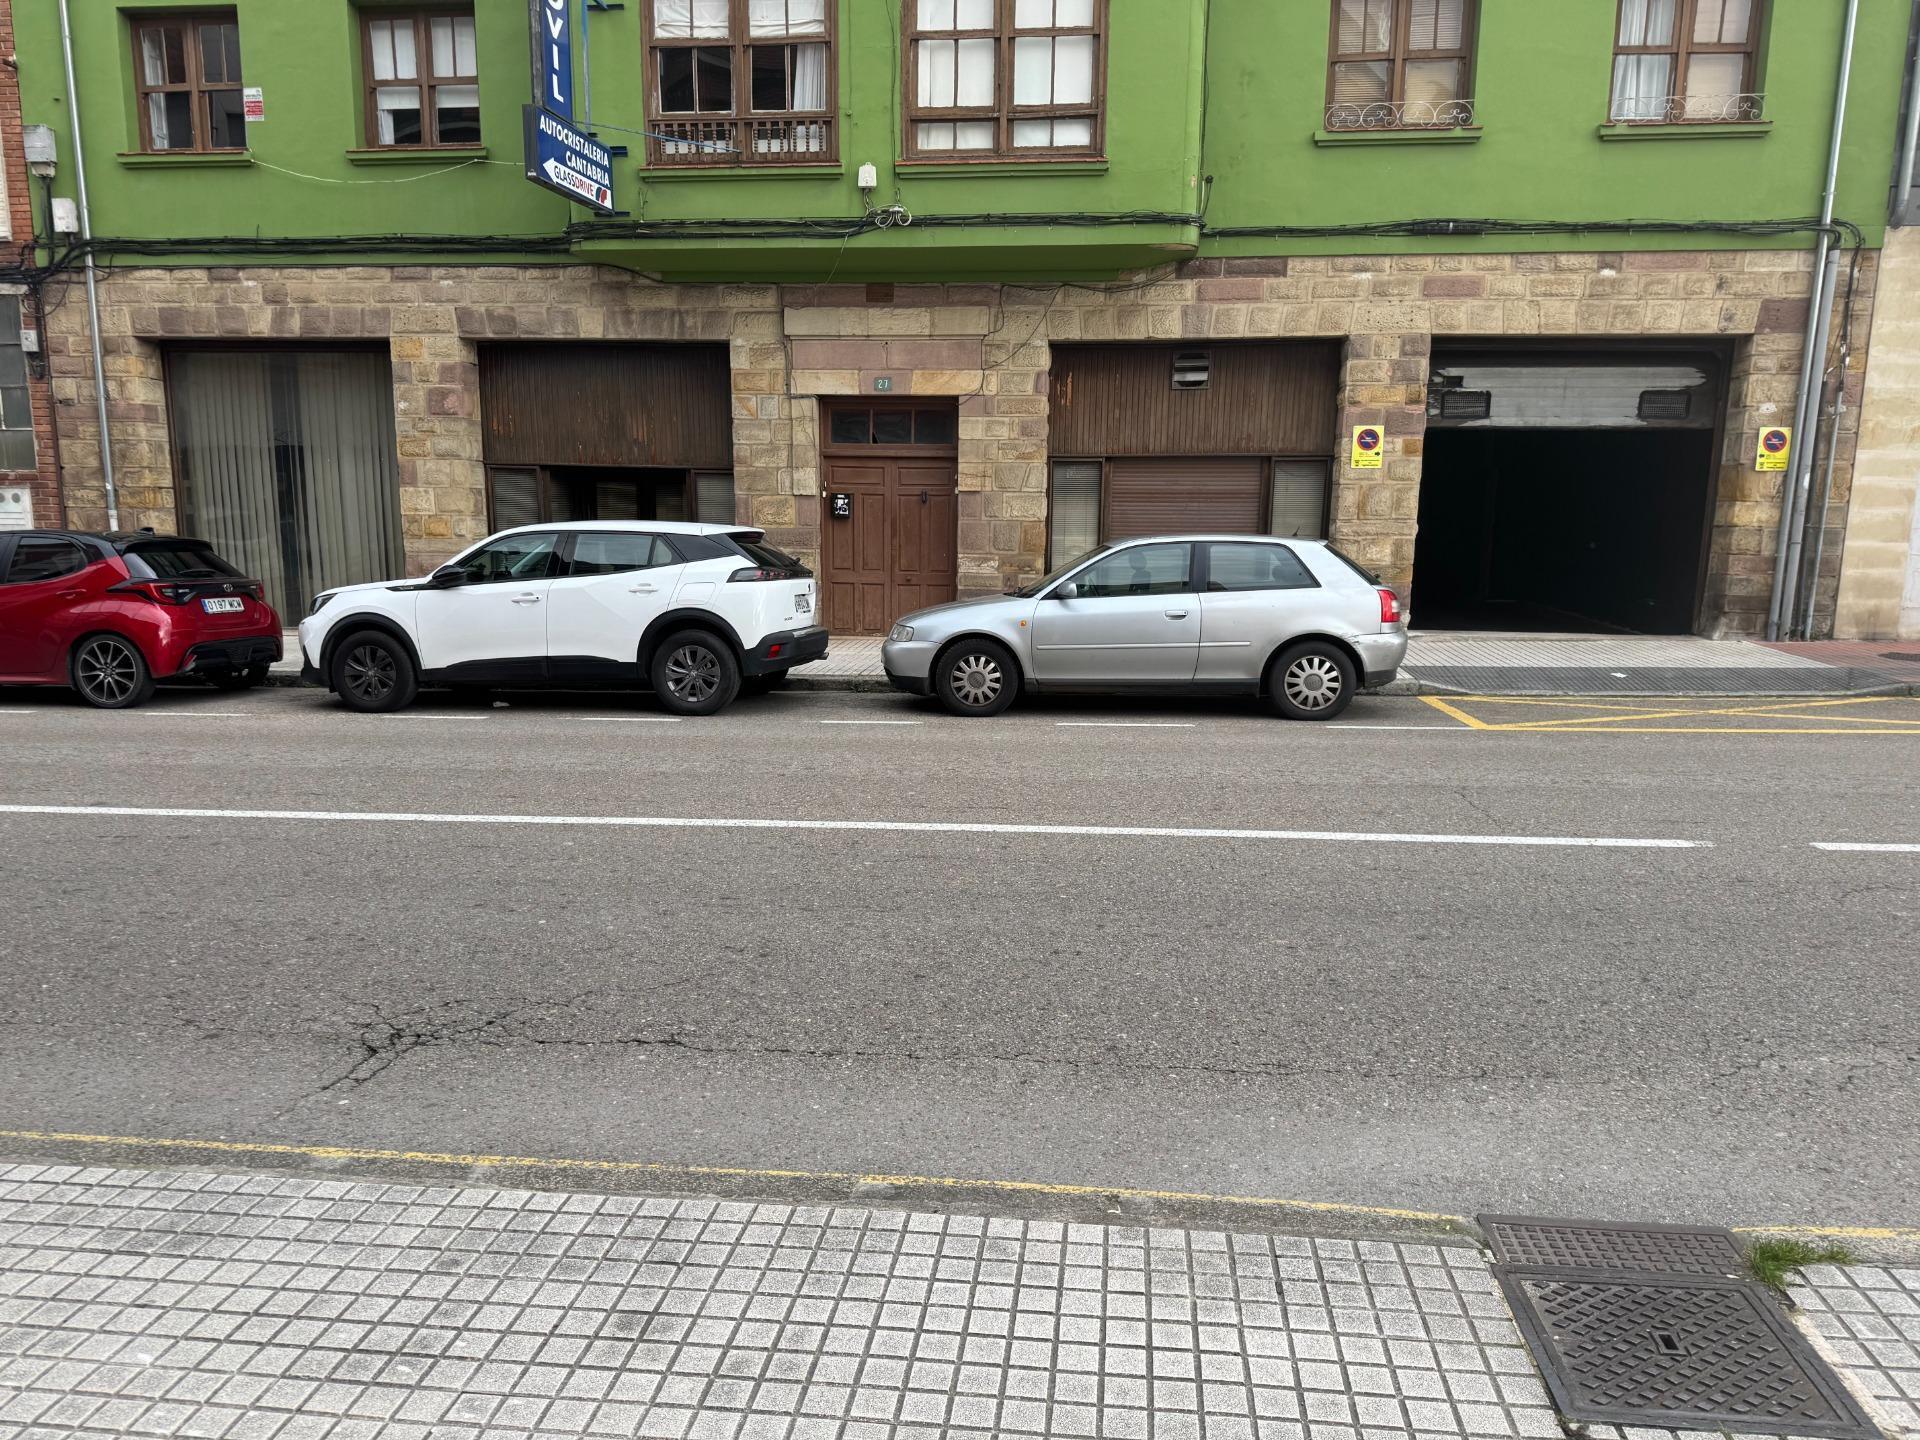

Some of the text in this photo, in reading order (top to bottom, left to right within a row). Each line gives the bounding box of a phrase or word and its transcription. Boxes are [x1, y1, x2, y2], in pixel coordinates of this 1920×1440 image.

[540, 115, 609, 168] AUTOCRISTALERIA
[554, 166, 594, 197] GLASSDRIVE
[566, 151, 610, 187] CANTABRIA
[878, 379, 888, 389] 27
[208, 600, 227, 610] 0197
